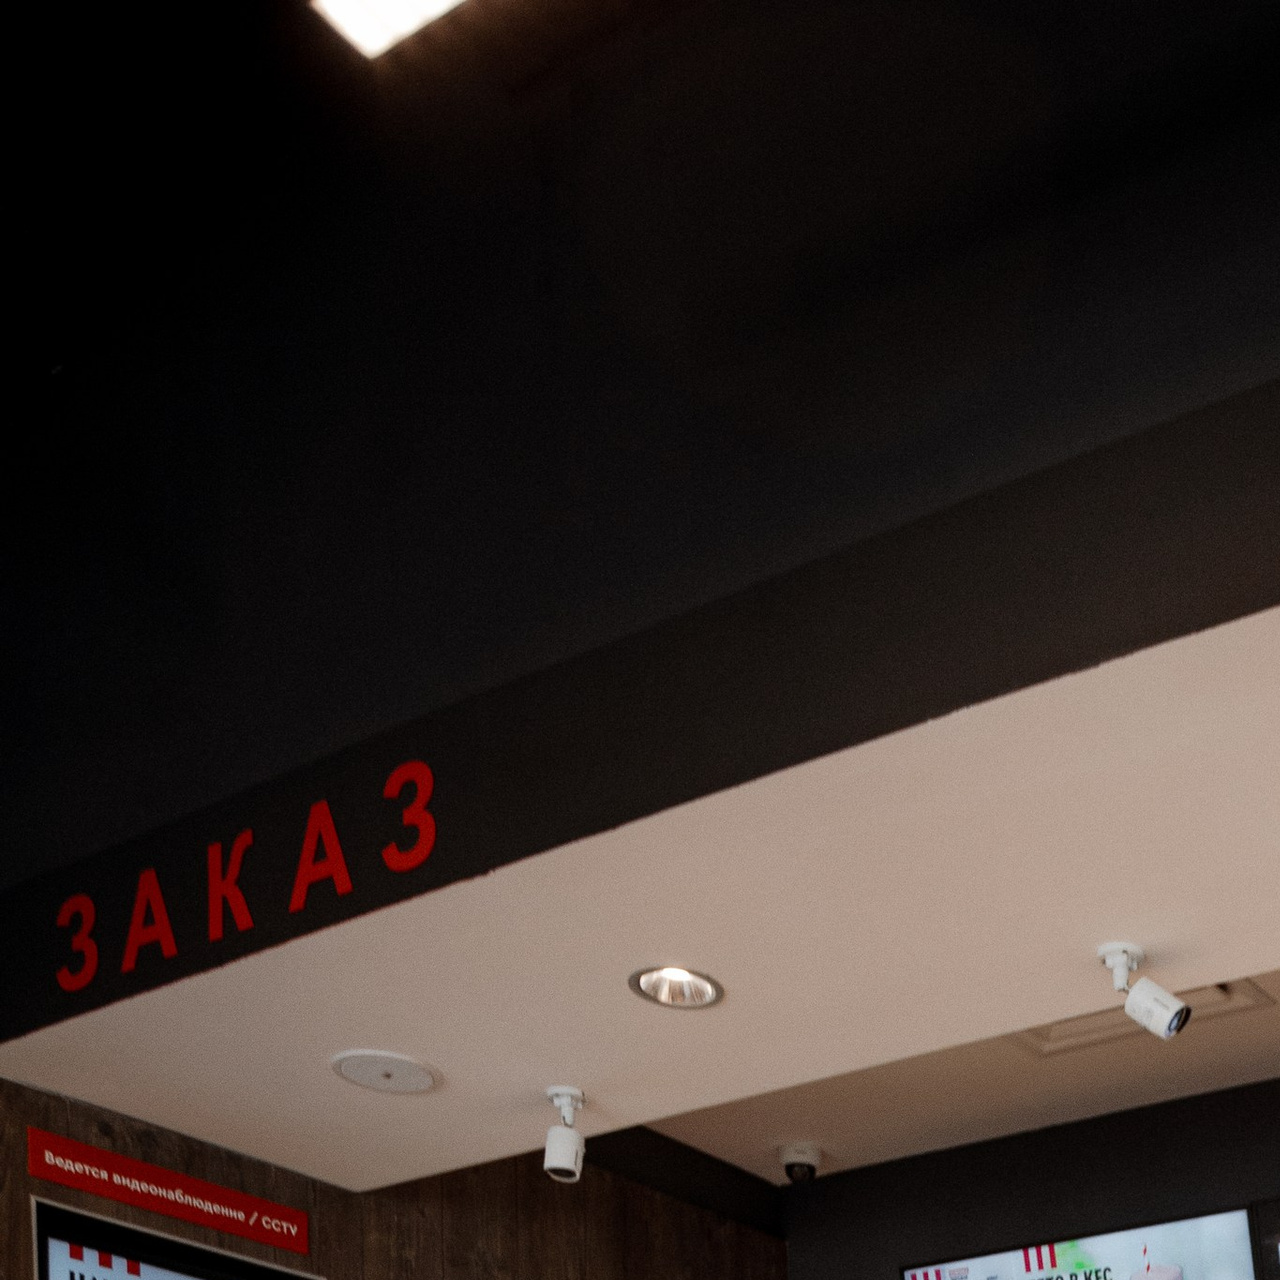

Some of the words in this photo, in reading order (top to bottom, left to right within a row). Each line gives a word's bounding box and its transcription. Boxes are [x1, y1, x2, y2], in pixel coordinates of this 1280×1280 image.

[55, 759, 437, 992] ЗАКАЗ
[44, 1148, 109, 1182] Ведется
[112, 1171, 246, 1223] видеонаблюдение
[261, 1215, 298, 1238] CCTV
